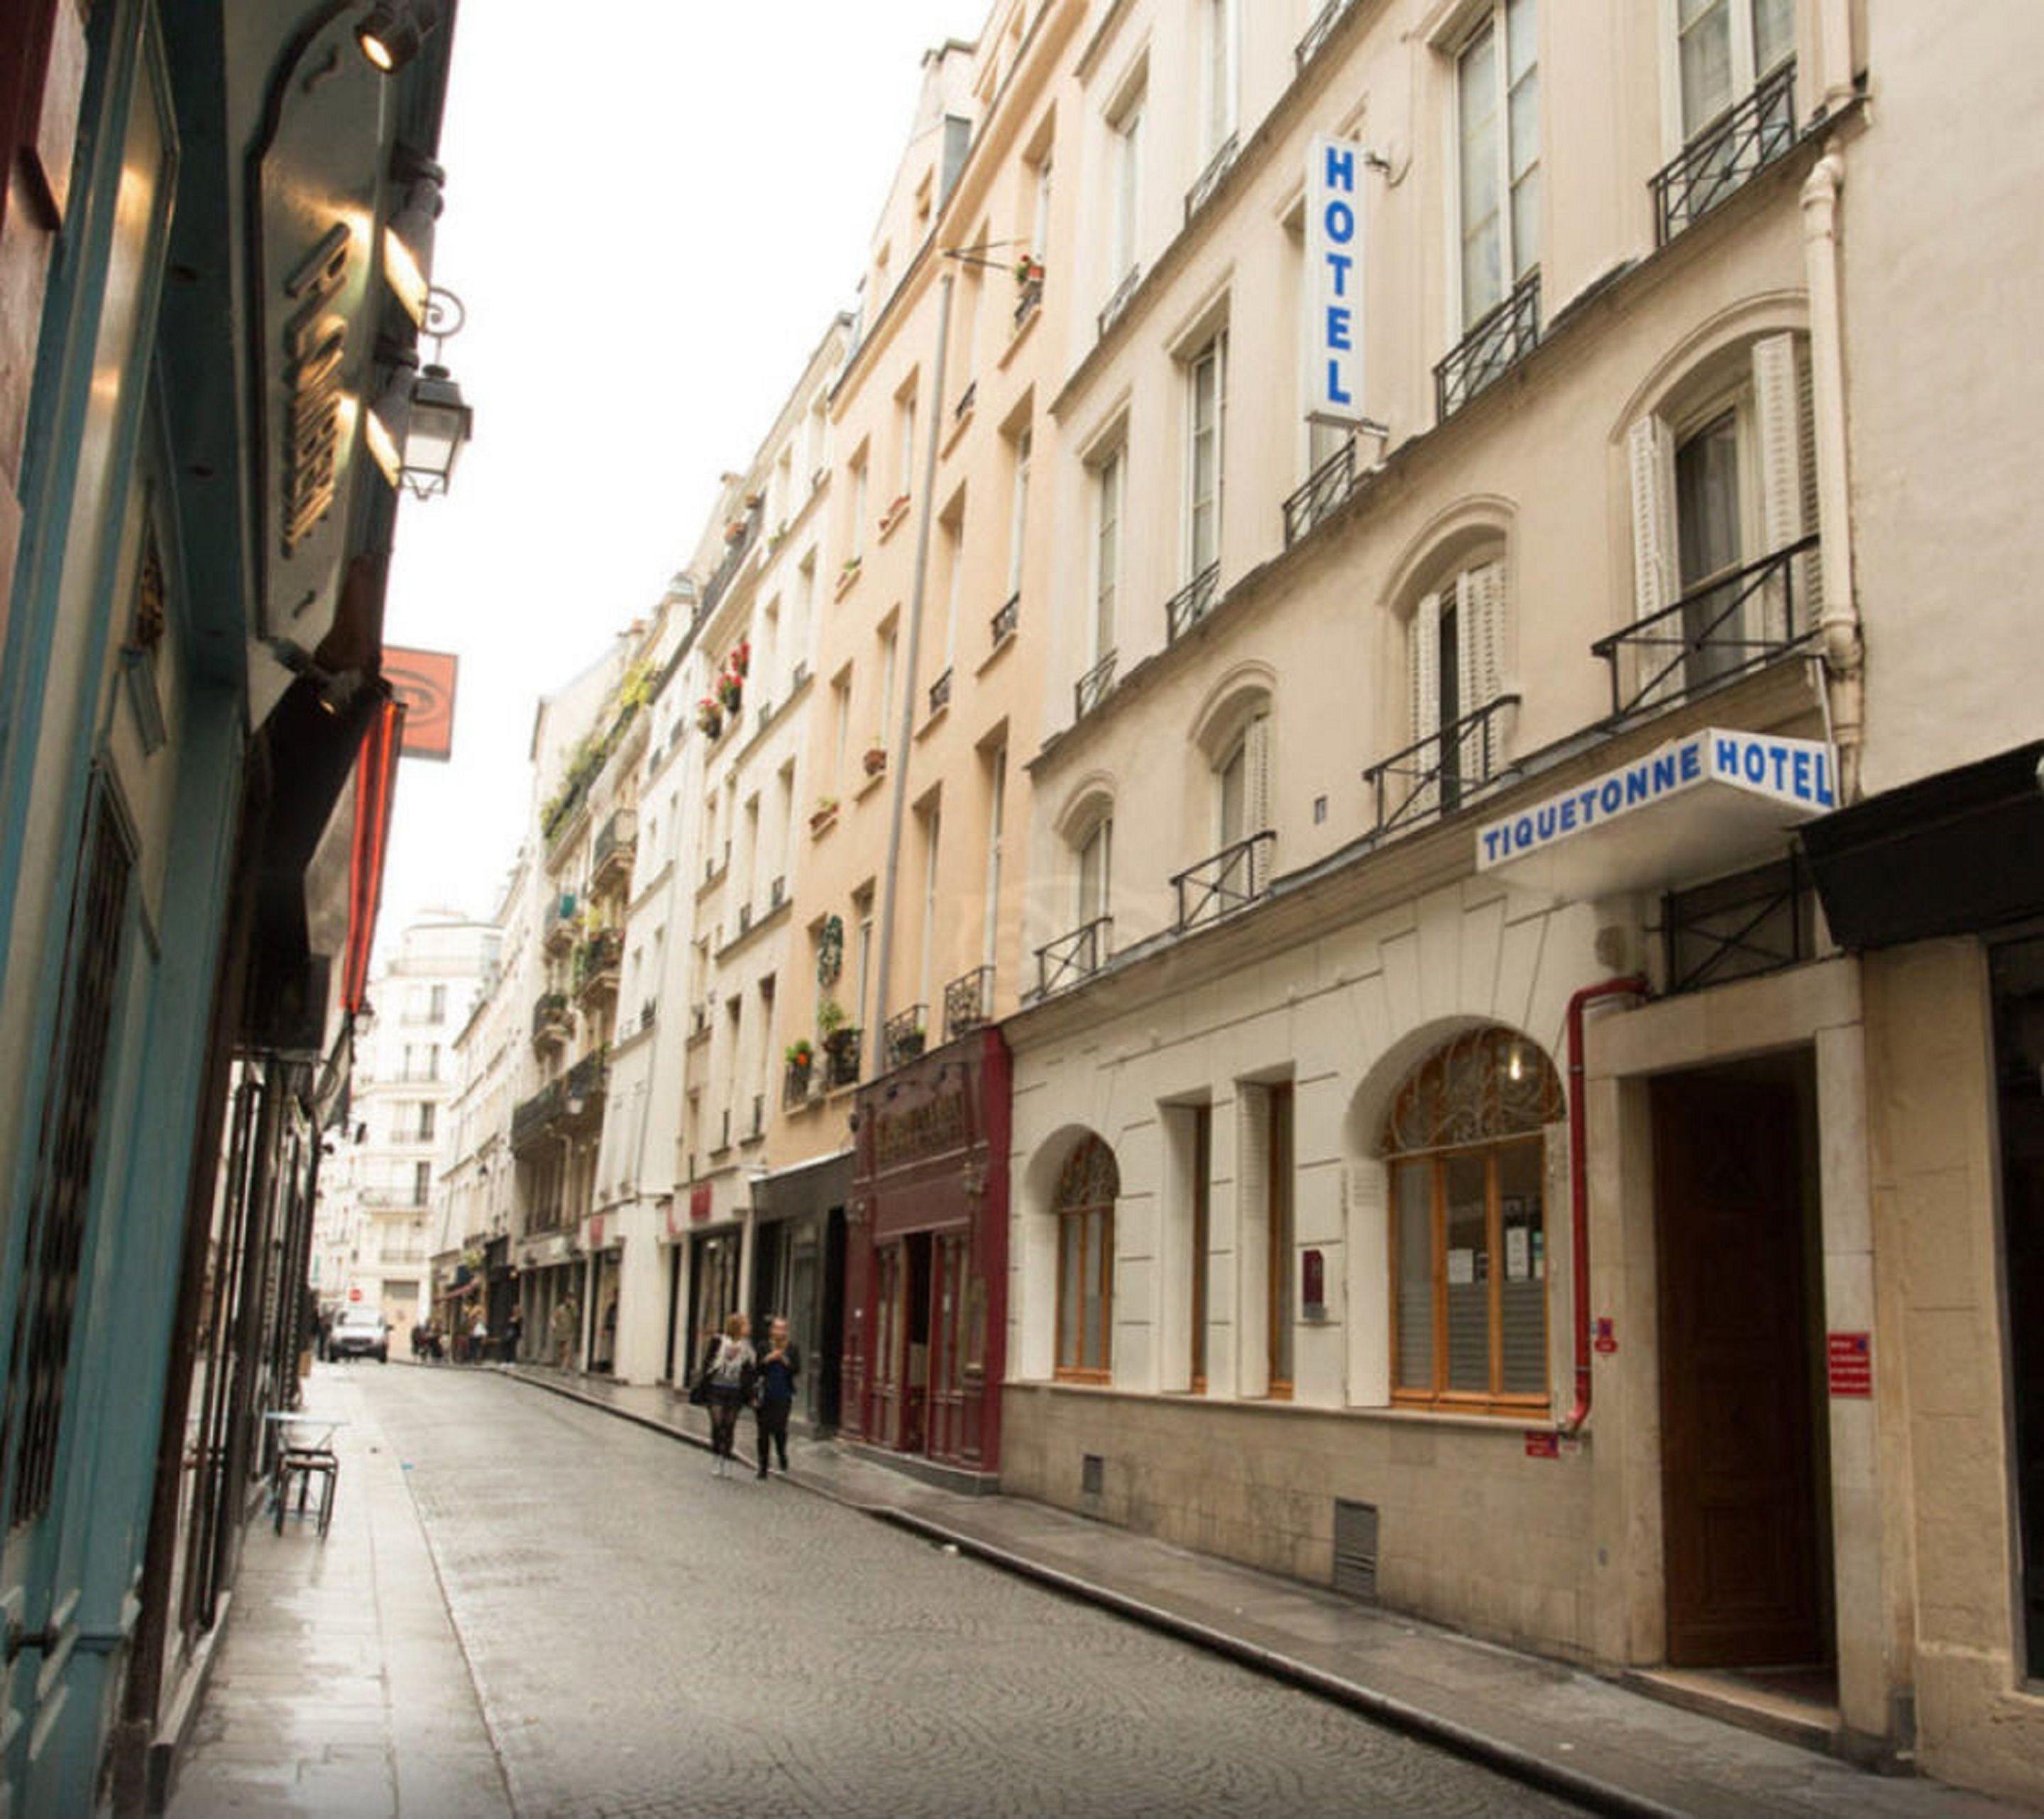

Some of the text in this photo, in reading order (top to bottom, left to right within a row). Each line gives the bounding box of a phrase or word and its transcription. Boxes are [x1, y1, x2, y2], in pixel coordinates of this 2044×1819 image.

[1325, 147, 1354, 405] HOTEL
[1483, 739, 1833, 860] TIQUETONNE HOTEL
